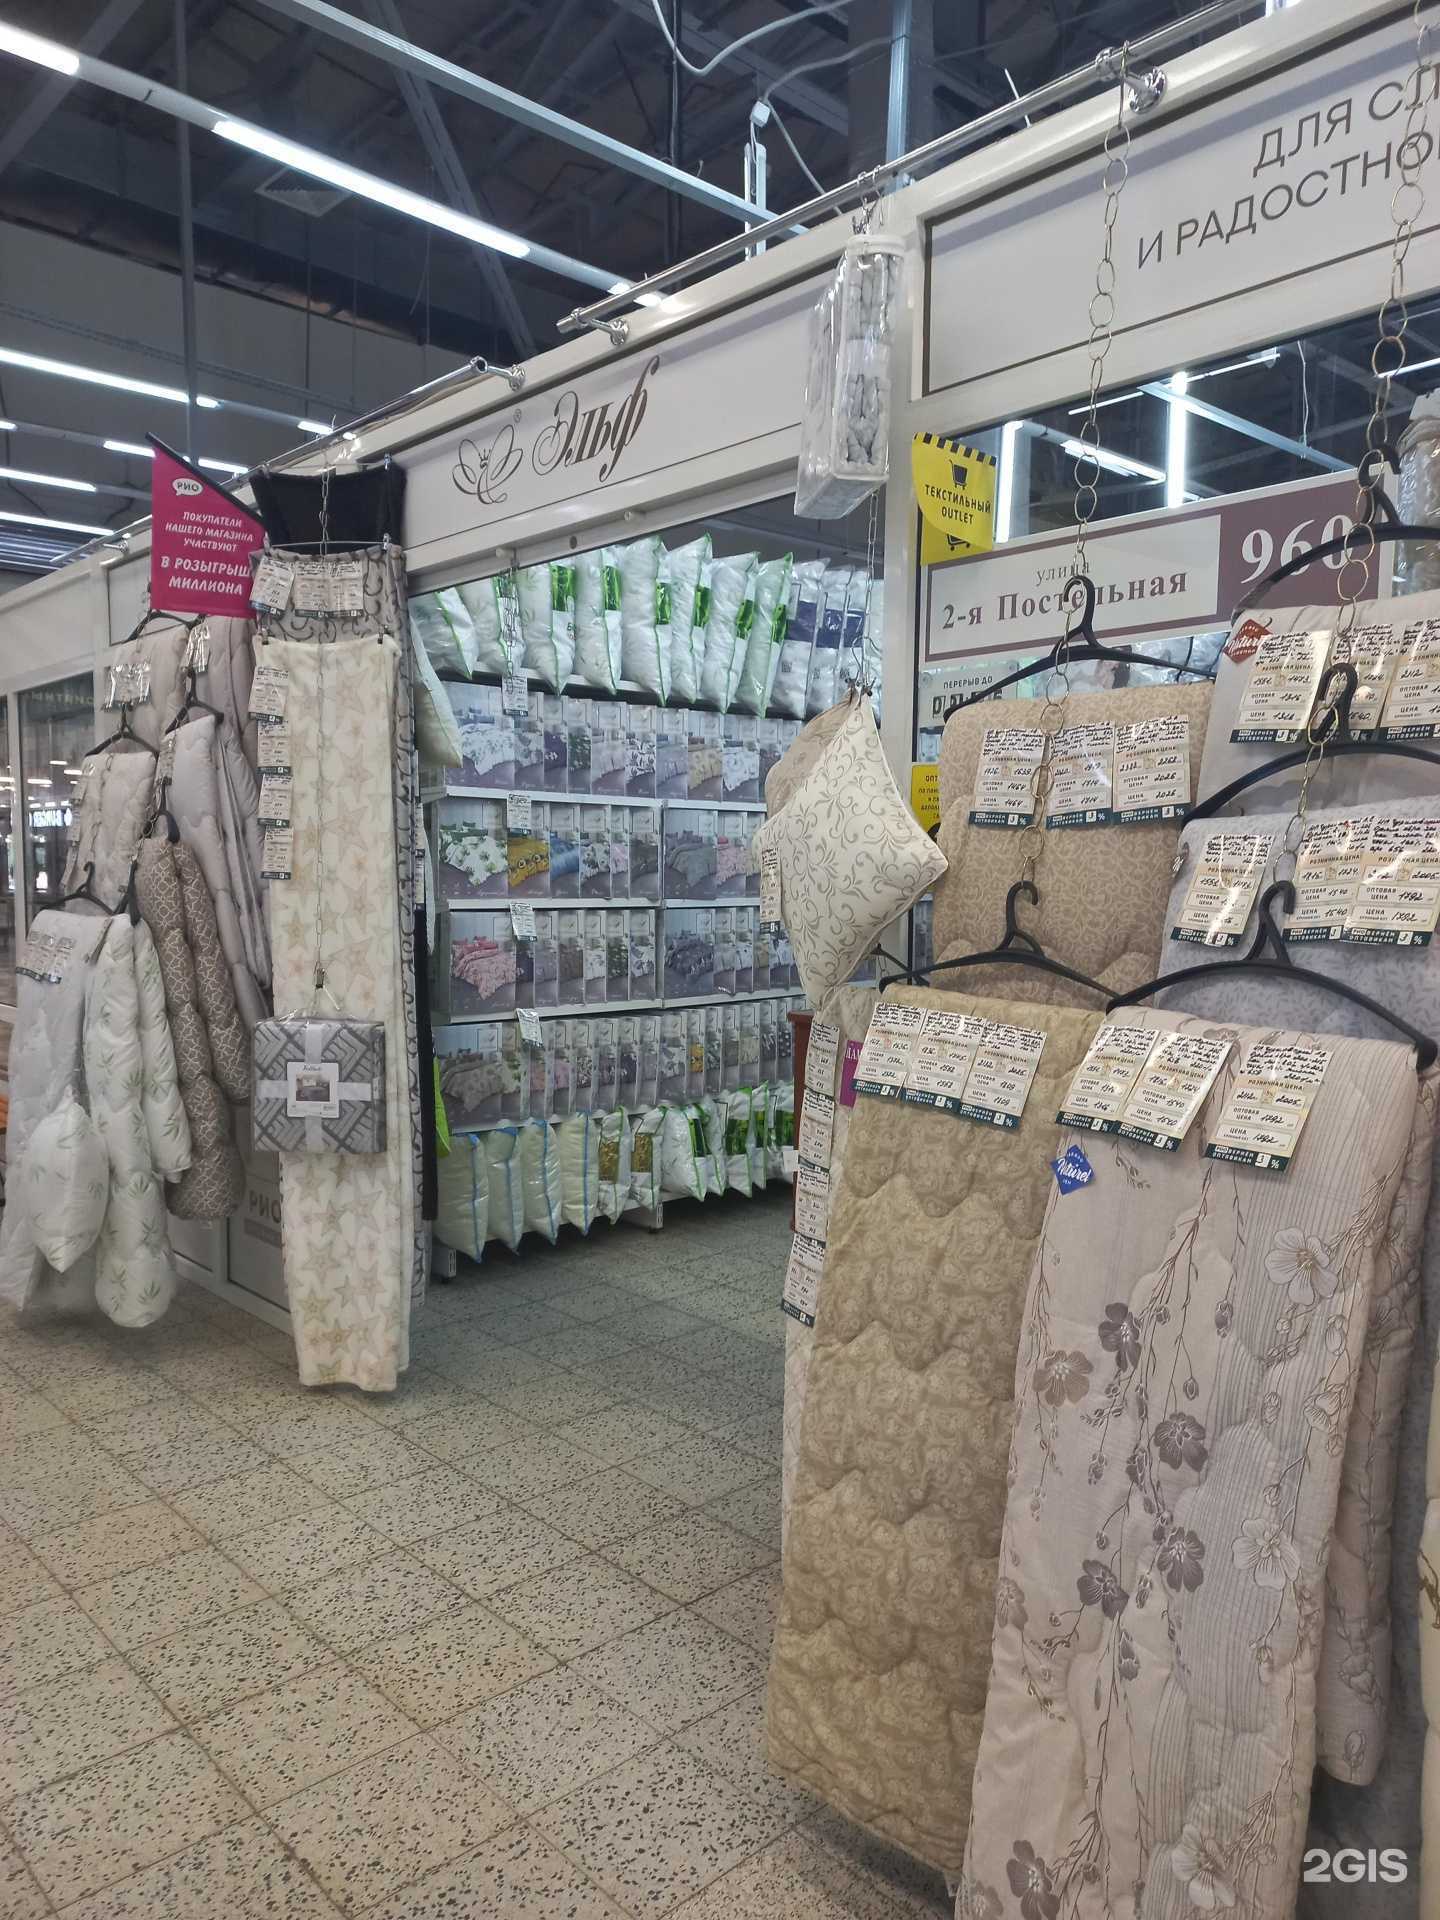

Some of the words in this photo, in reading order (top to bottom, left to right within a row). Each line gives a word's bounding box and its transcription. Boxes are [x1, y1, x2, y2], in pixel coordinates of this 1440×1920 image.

[1253, 98, 1353, 178] ДЛЯ
[1138, 230, 1163, 269] И
[1176, 130, 1440, 256] РАДОСТНО
[532, 355, 660, 482] Эльф
[176, 481, 200, 492] РИО
[925, 484, 991, 513] ТЕКСТИЛЬНЫЙ
[183, 511, 242, 528] ПОКУПАТЕЛИ
[942, 506, 974, 524] OUTLET
[165, 522, 203, 535] НАШЕГО
[205, 527, 253, 542] МАГАЗИНА
[184, 537, 238, 552] УЧАСТВУЮТ
[1241, 514, 1356, 584] 960
[161, 556, 170, 568] В
[169, 576, 243, 595] МИЛЛИОНА
[942, 603, 982, 630] 2-я
[943, 677, 980, 689] ПЕРЕРЫВ
[981, 675, 993, 684] ДО
[1413, 935, 1422, 945] %
[1271, 1159, 1279, 1168] %
